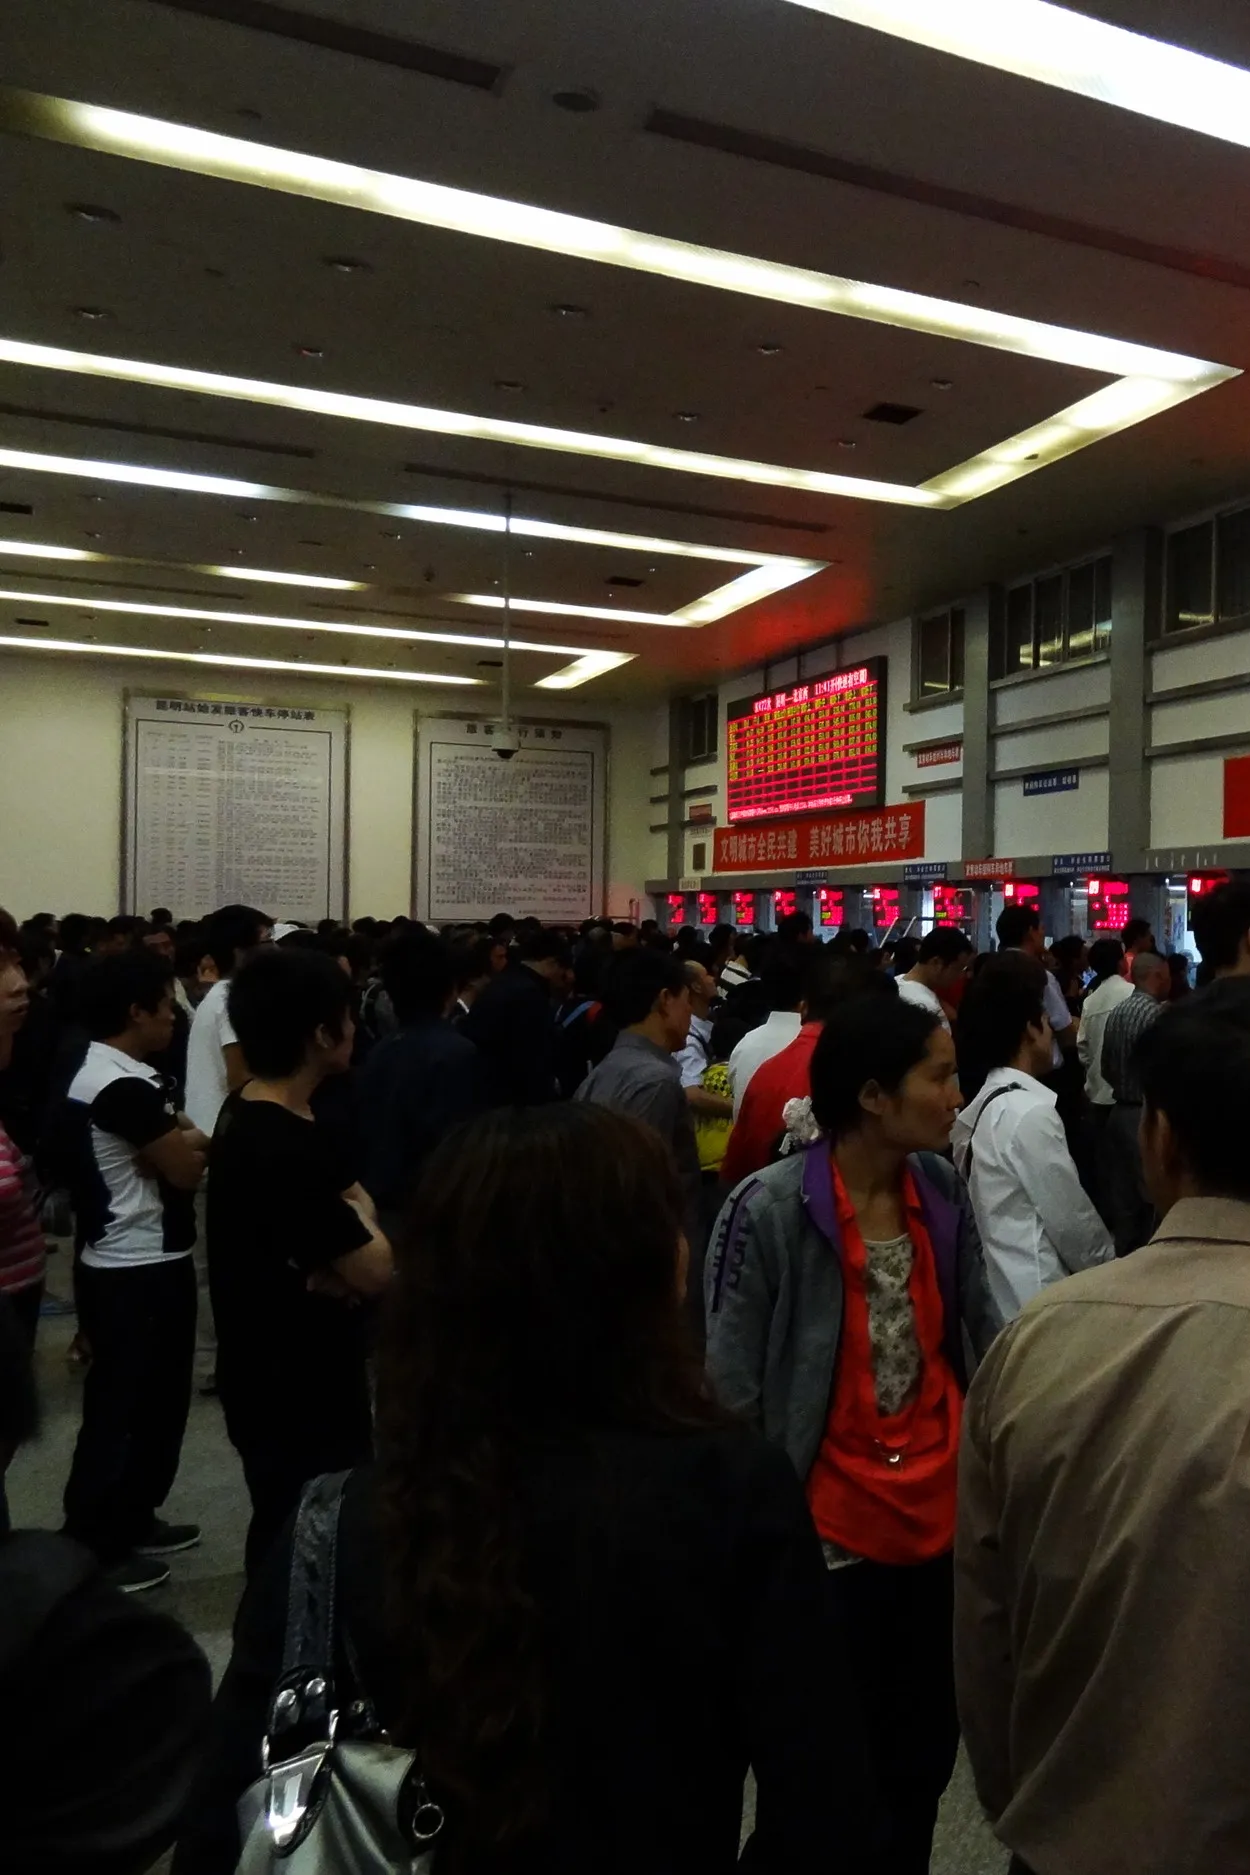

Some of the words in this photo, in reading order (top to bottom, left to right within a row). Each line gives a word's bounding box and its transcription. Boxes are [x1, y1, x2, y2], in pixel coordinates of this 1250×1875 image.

[466, 723, 562, 740] 旅客行须知
[809, 813, 912, 858] 美好城市你我共享
